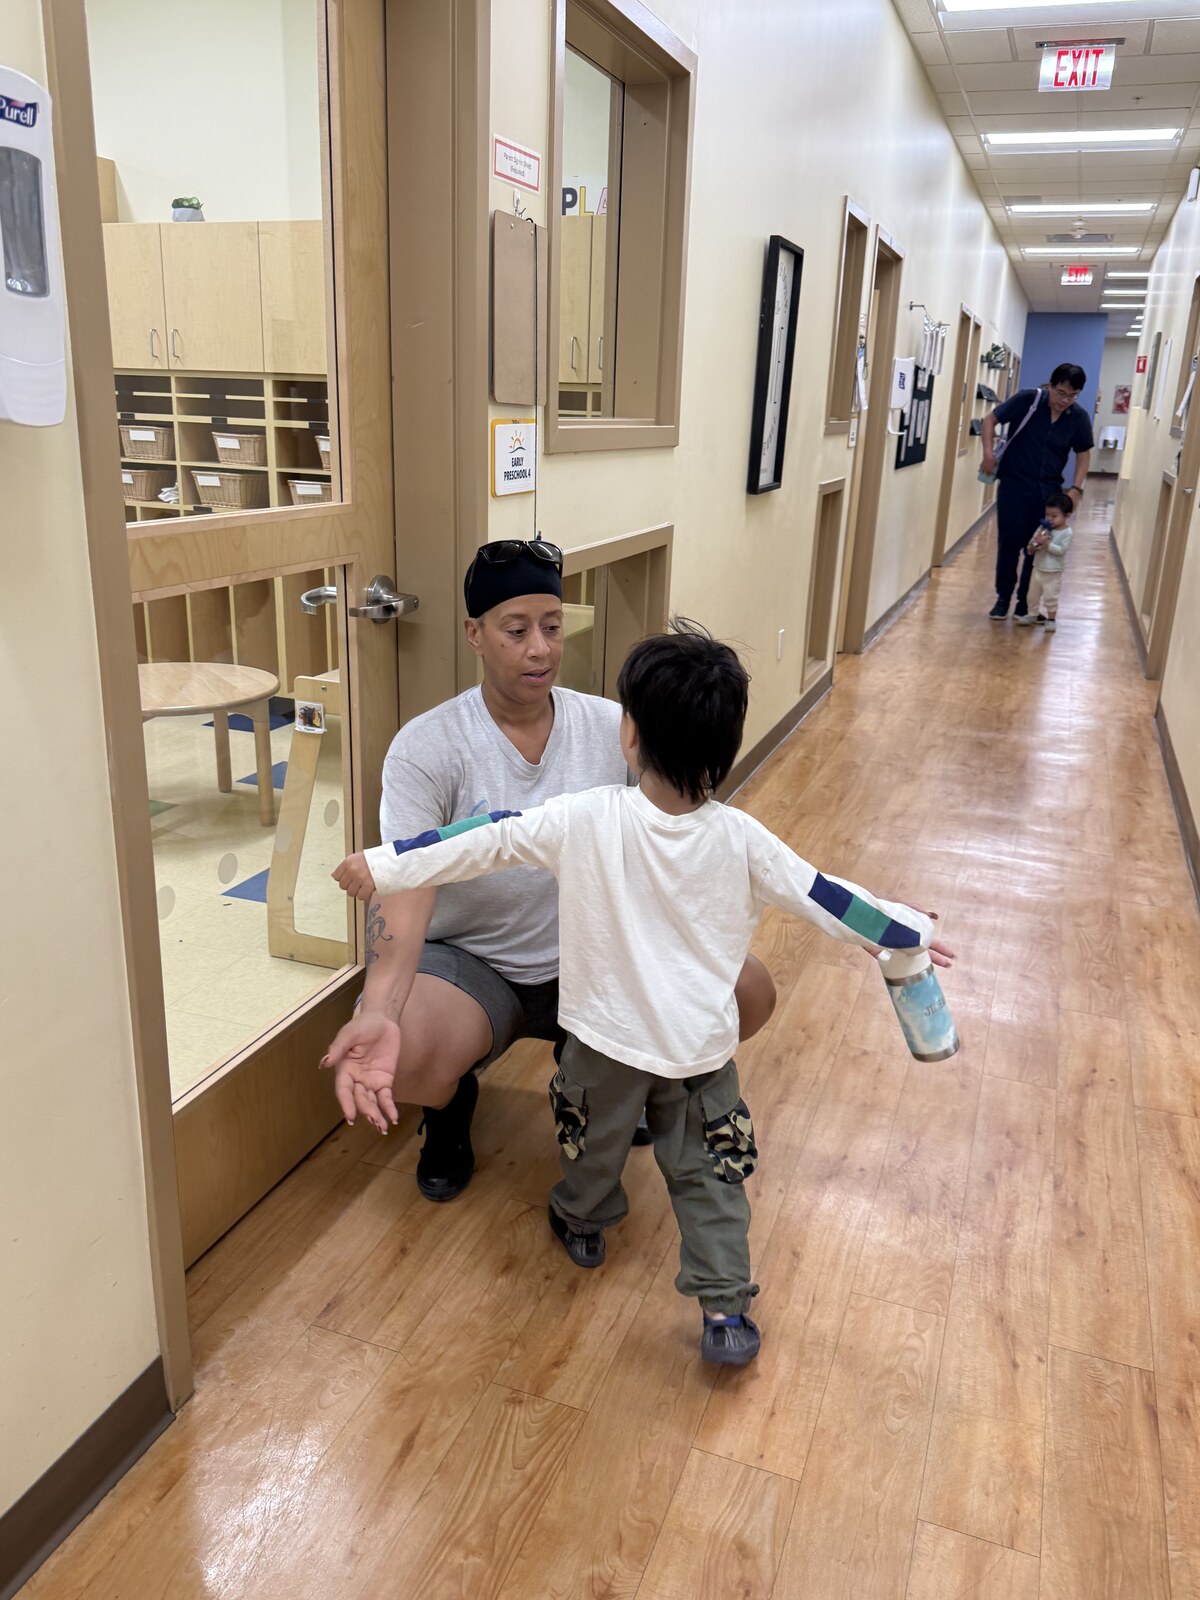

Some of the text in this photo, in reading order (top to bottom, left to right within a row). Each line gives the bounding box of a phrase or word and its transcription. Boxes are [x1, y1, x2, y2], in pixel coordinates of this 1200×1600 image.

[1053, 49, 1105, 87] EXIT
[511, 457, 524, 467] EARLY
[503, 469, 527, 481] PRESCHOOL
